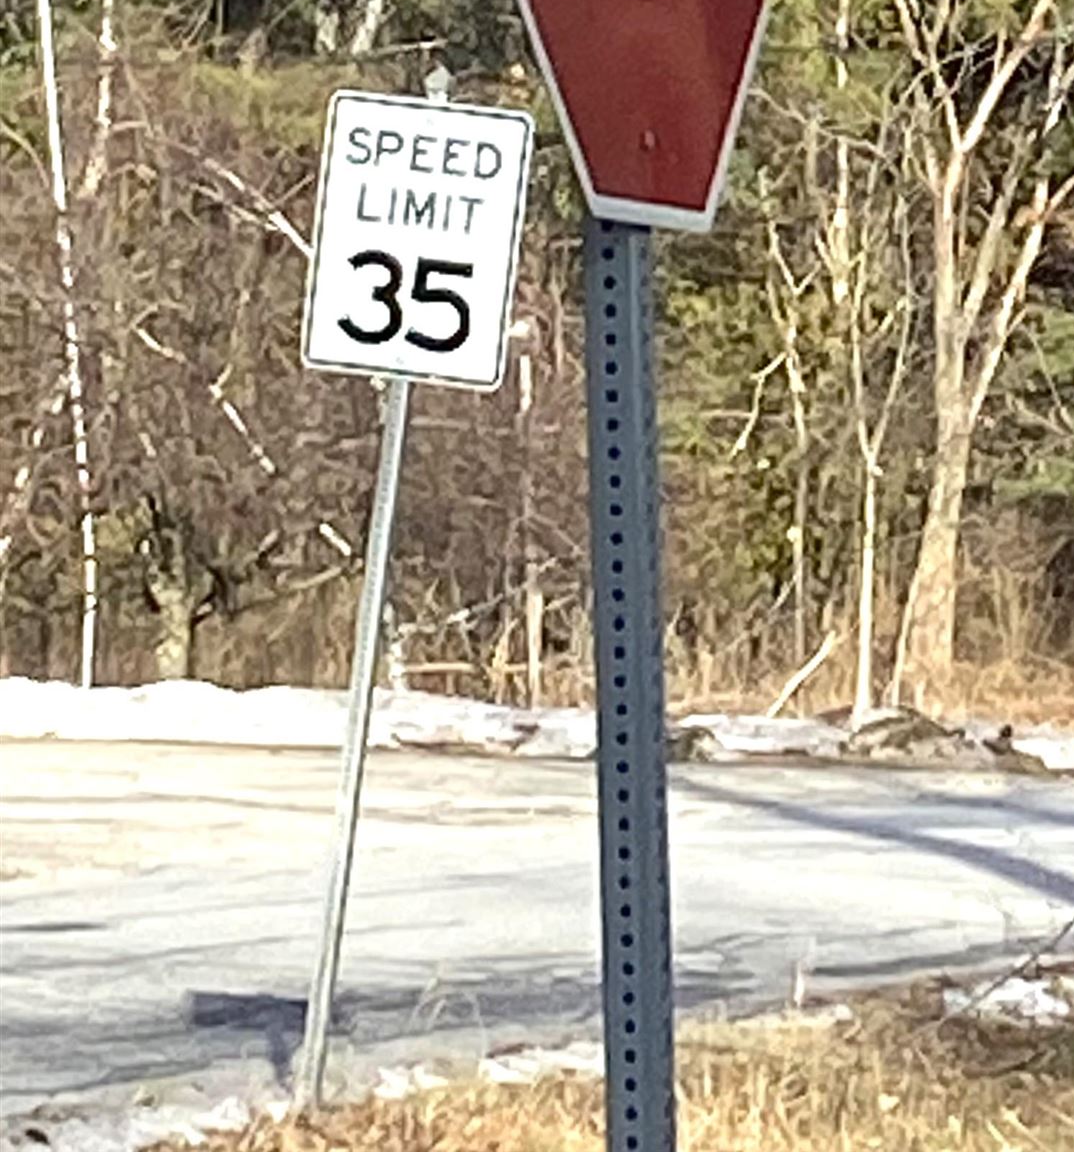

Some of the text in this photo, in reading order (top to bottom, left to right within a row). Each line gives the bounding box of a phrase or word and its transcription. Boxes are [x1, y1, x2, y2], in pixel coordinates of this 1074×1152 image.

[346, 127, 502, 180] SPEED
[356, 183, 484, 235] LIMIT
[337, 249, 473, 353] 35
